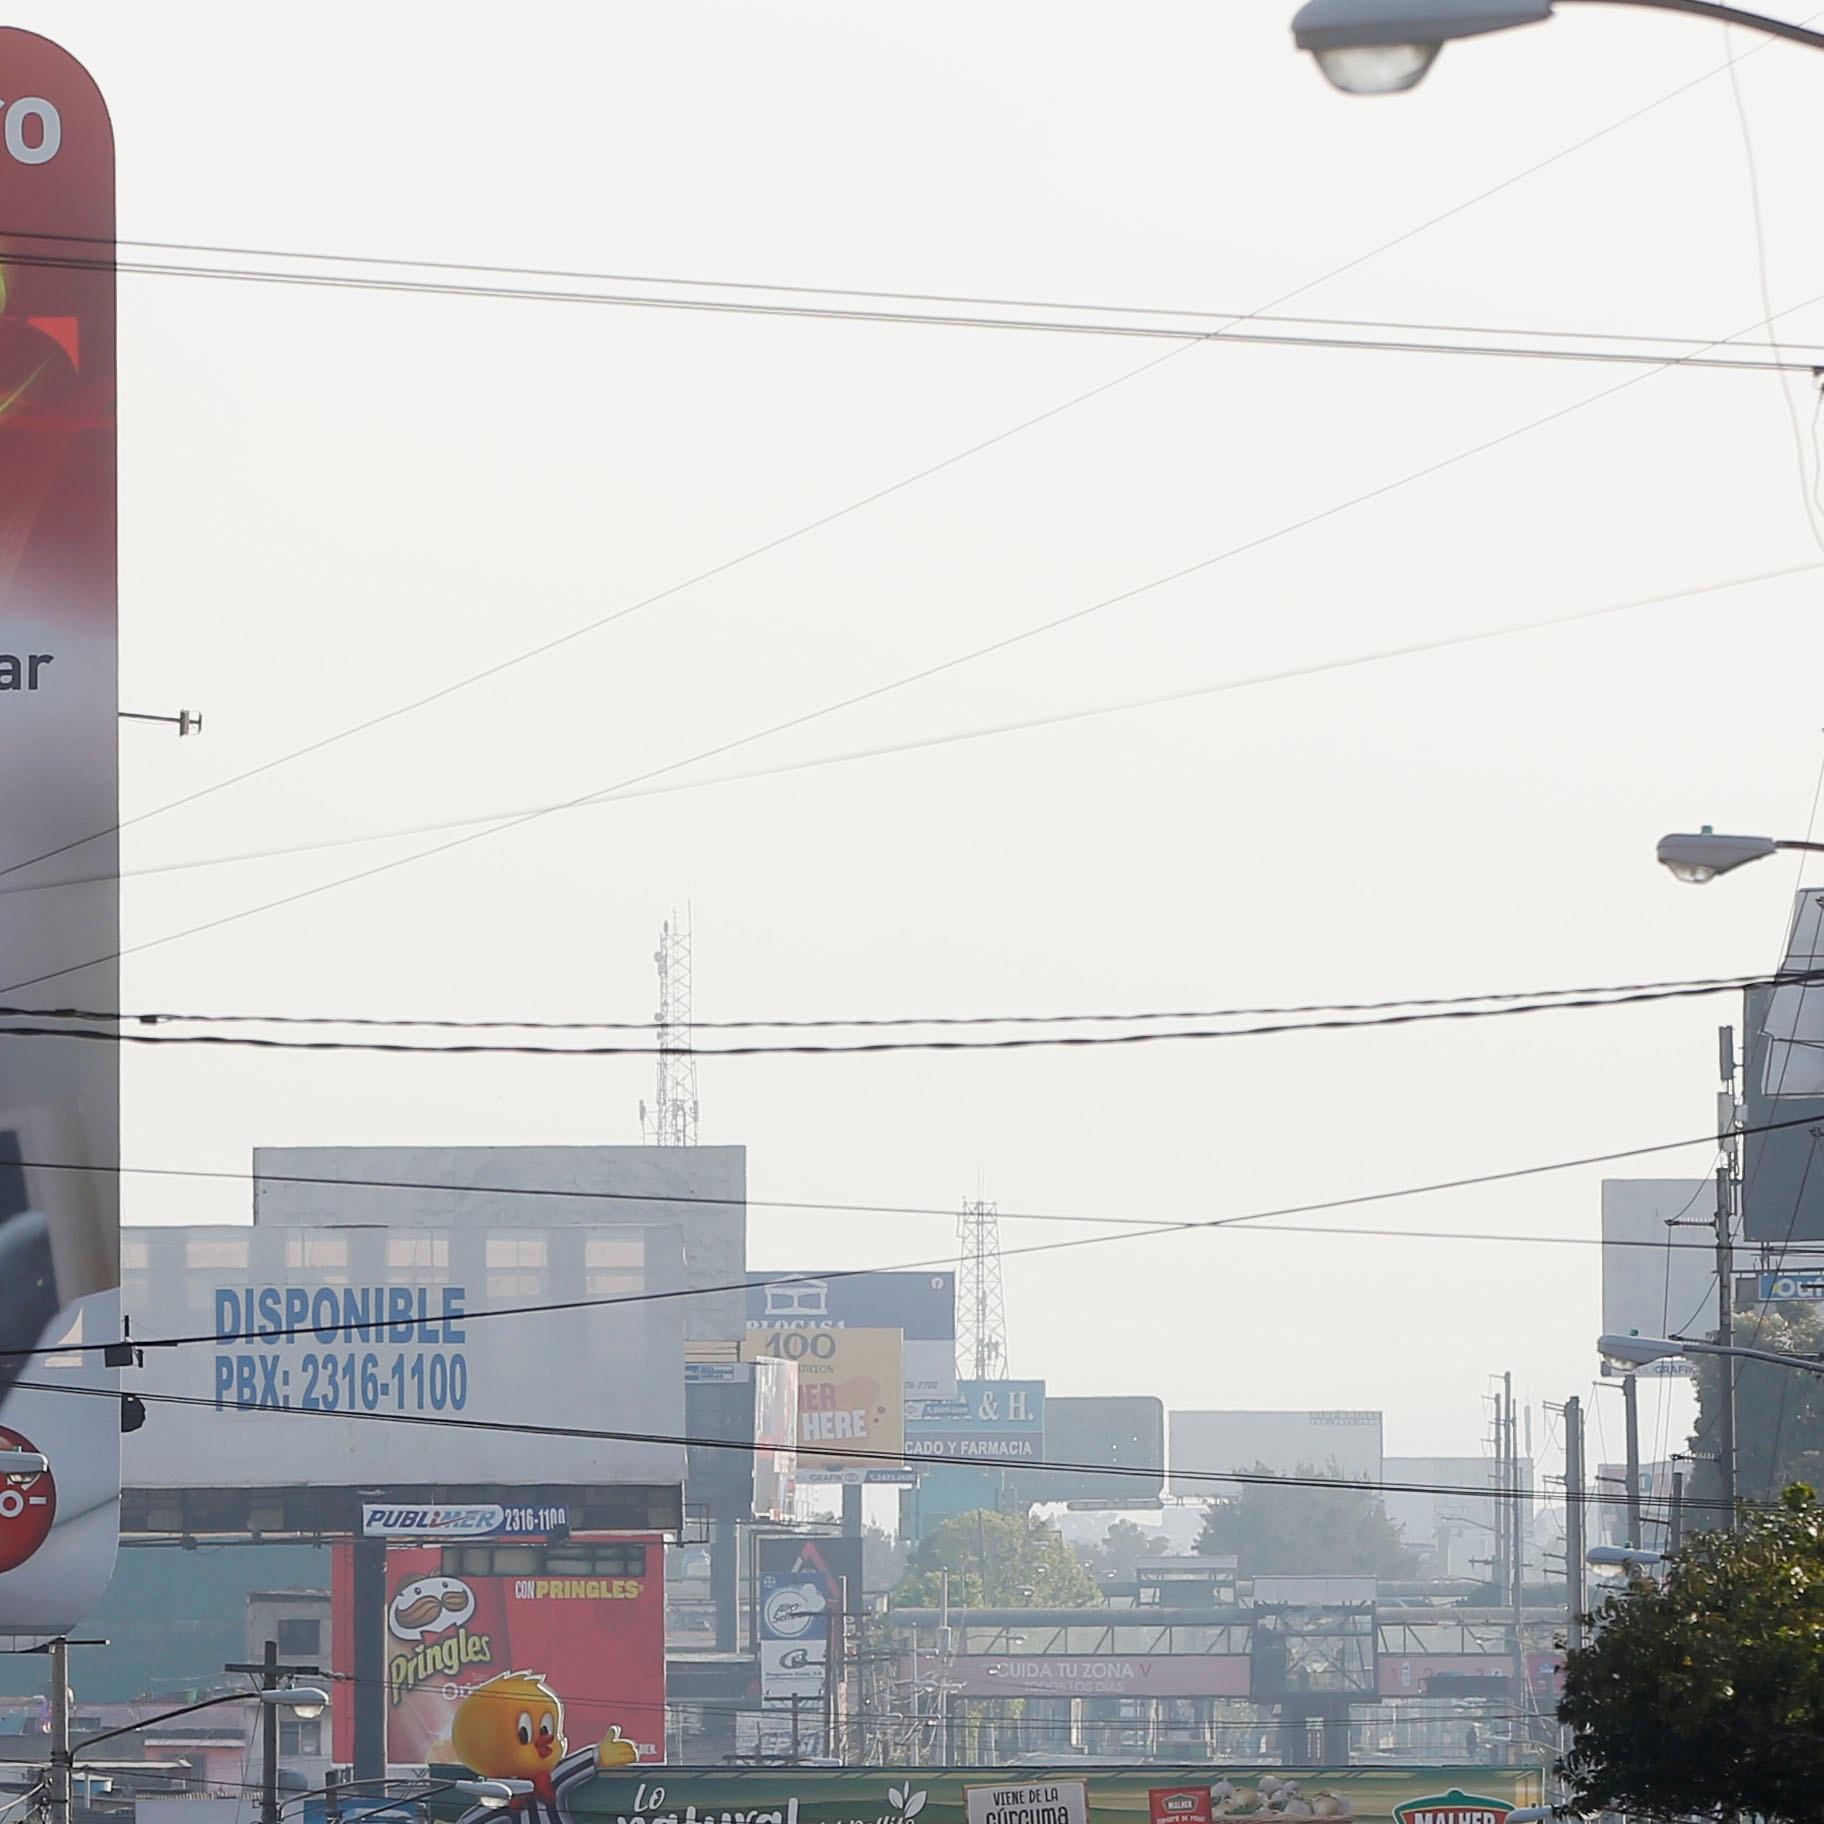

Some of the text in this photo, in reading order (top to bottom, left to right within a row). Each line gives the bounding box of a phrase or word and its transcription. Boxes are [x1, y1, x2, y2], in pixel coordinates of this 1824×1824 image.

[214, 1286, 467, 1345] DISPONIBLE
[214, 1352, 468, 1413] PBX: 2316-1100
[803, 1409, 867, 1441] HERE
[948, 1440, 958, 1455] Y
[960, 1440, 1032, 1456] FARMACIA
[514, 1580, 639, 1600] CON PRINGLES
[385, 1627, 492, 1705] Pringles
[1056, 1662, 1076, 1679] TU
[1081, 1662, 1136, 1679] ZONA
[634, 1783, 666, 1813] Lo
[992, 1787, 1059, 1807] VIENE DE LA
